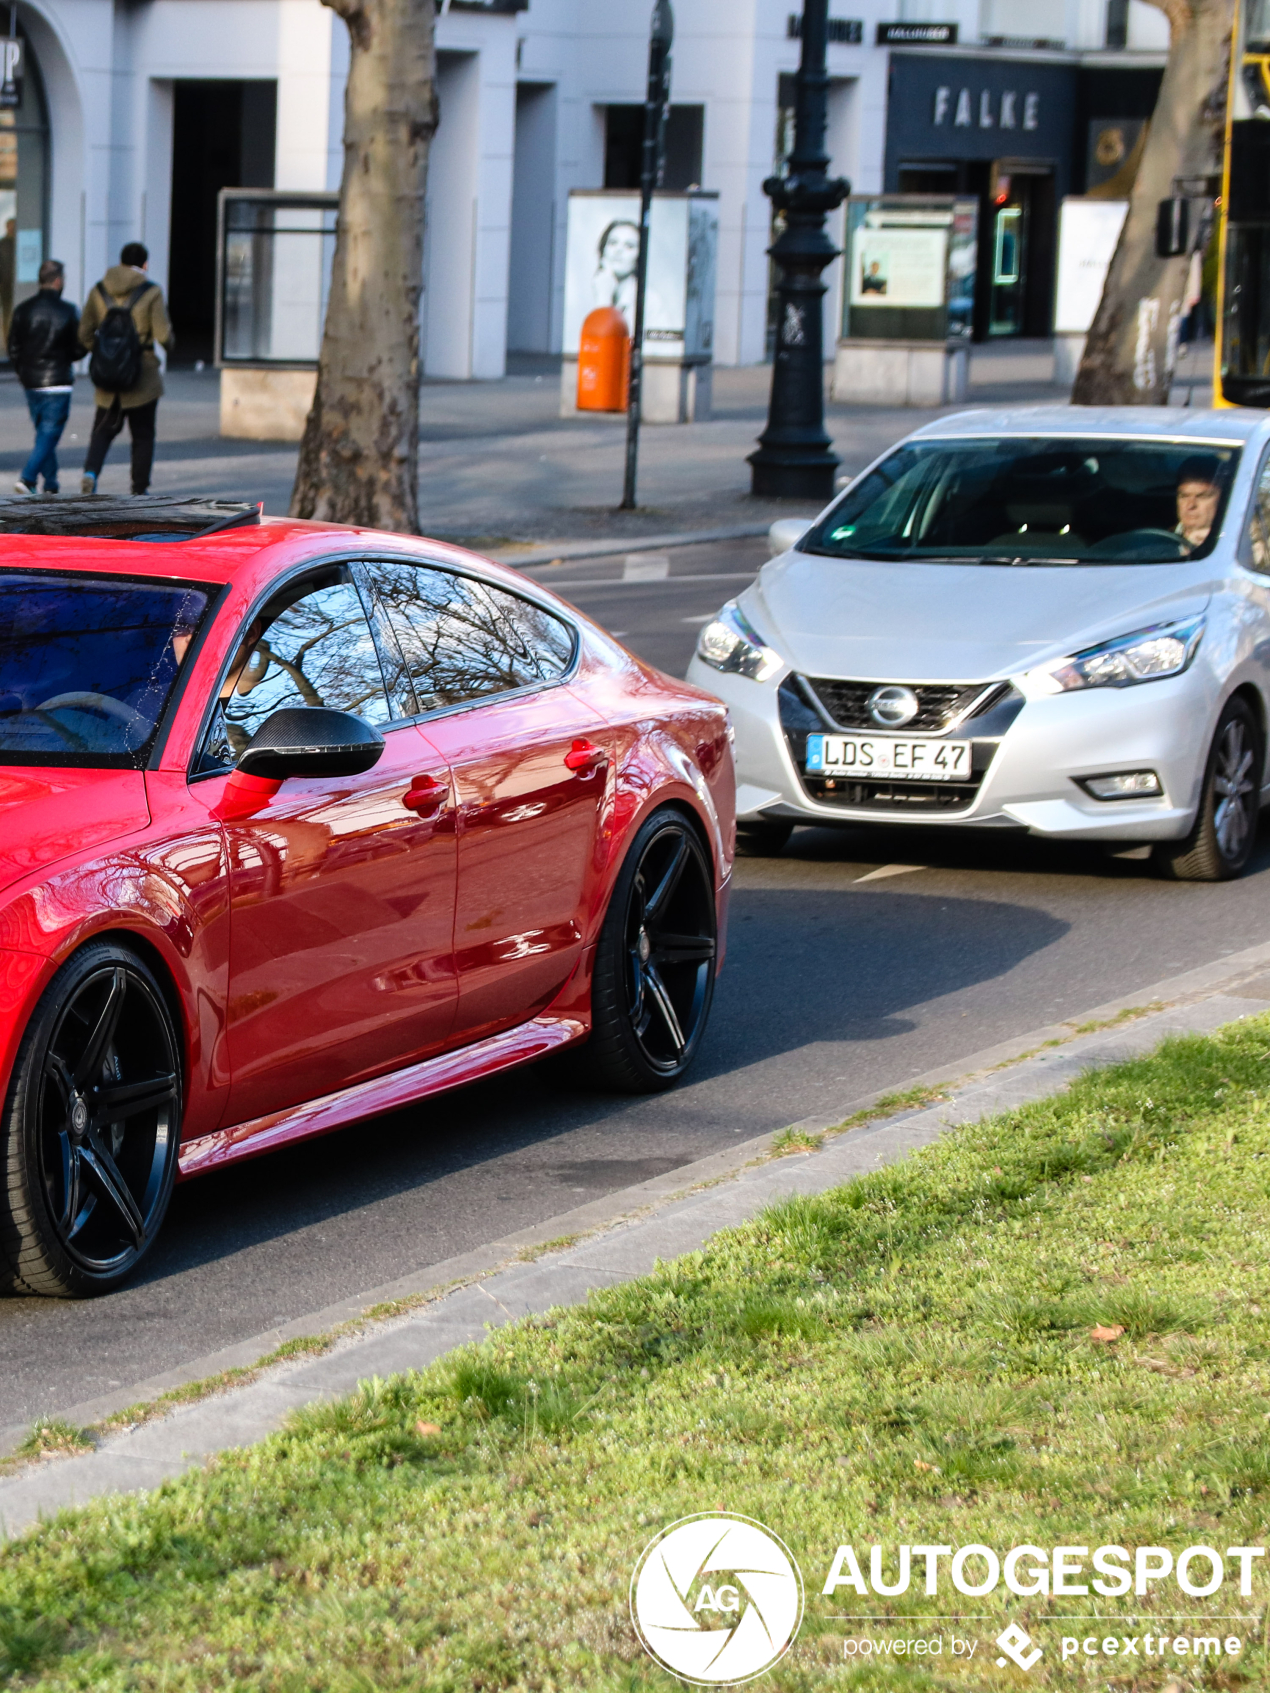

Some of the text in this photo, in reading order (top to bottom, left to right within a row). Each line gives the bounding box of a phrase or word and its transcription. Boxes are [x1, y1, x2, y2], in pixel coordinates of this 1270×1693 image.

[934, 86, 1040, 131] FALKE
[825, 741, 966, 770] LDS EF 47
